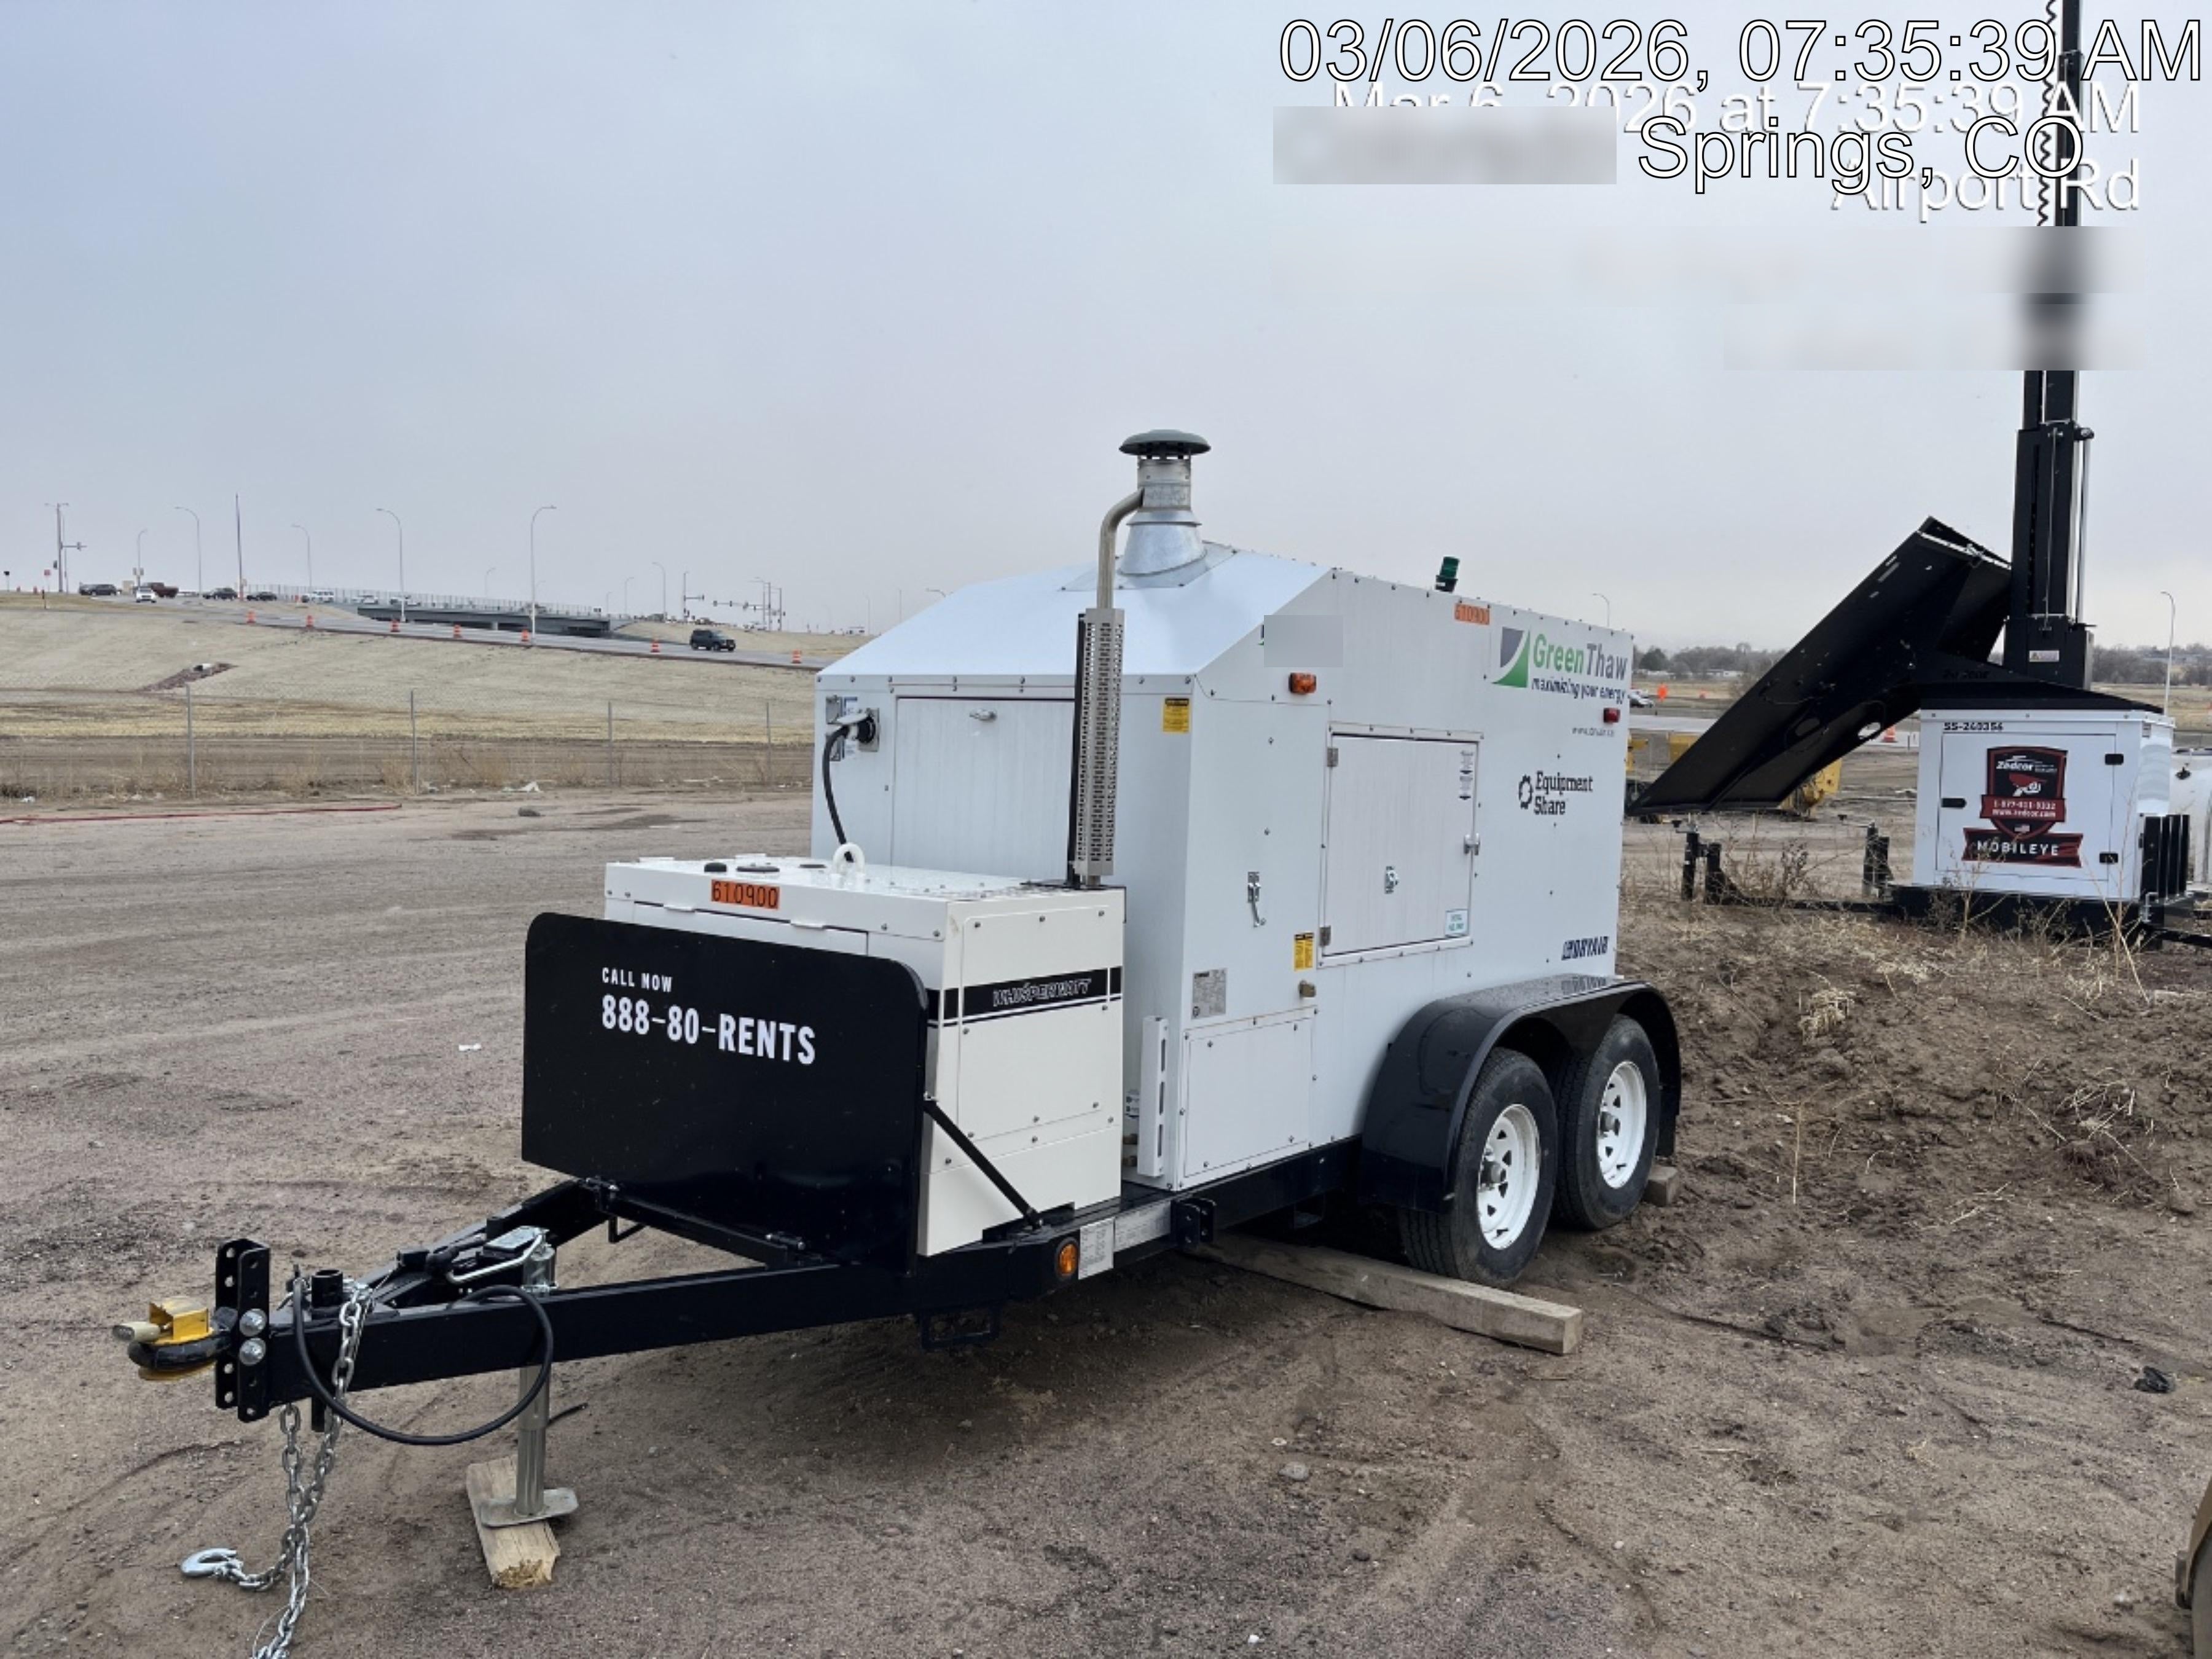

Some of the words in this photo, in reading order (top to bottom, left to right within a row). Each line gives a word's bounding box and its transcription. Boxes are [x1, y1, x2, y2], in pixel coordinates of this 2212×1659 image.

[1535, 771, 1593, 795] Equipment
[1534, 795, 1566, 815] Share
[1977, 840, 2060, 856] MOBILEYE
[712, 880, 779, 909] 610900
[602, 967, 635, 987] CALL
[641, 972, 673, 993] NOW
[602, 994, 816, 1065] 888-80-RENTS
